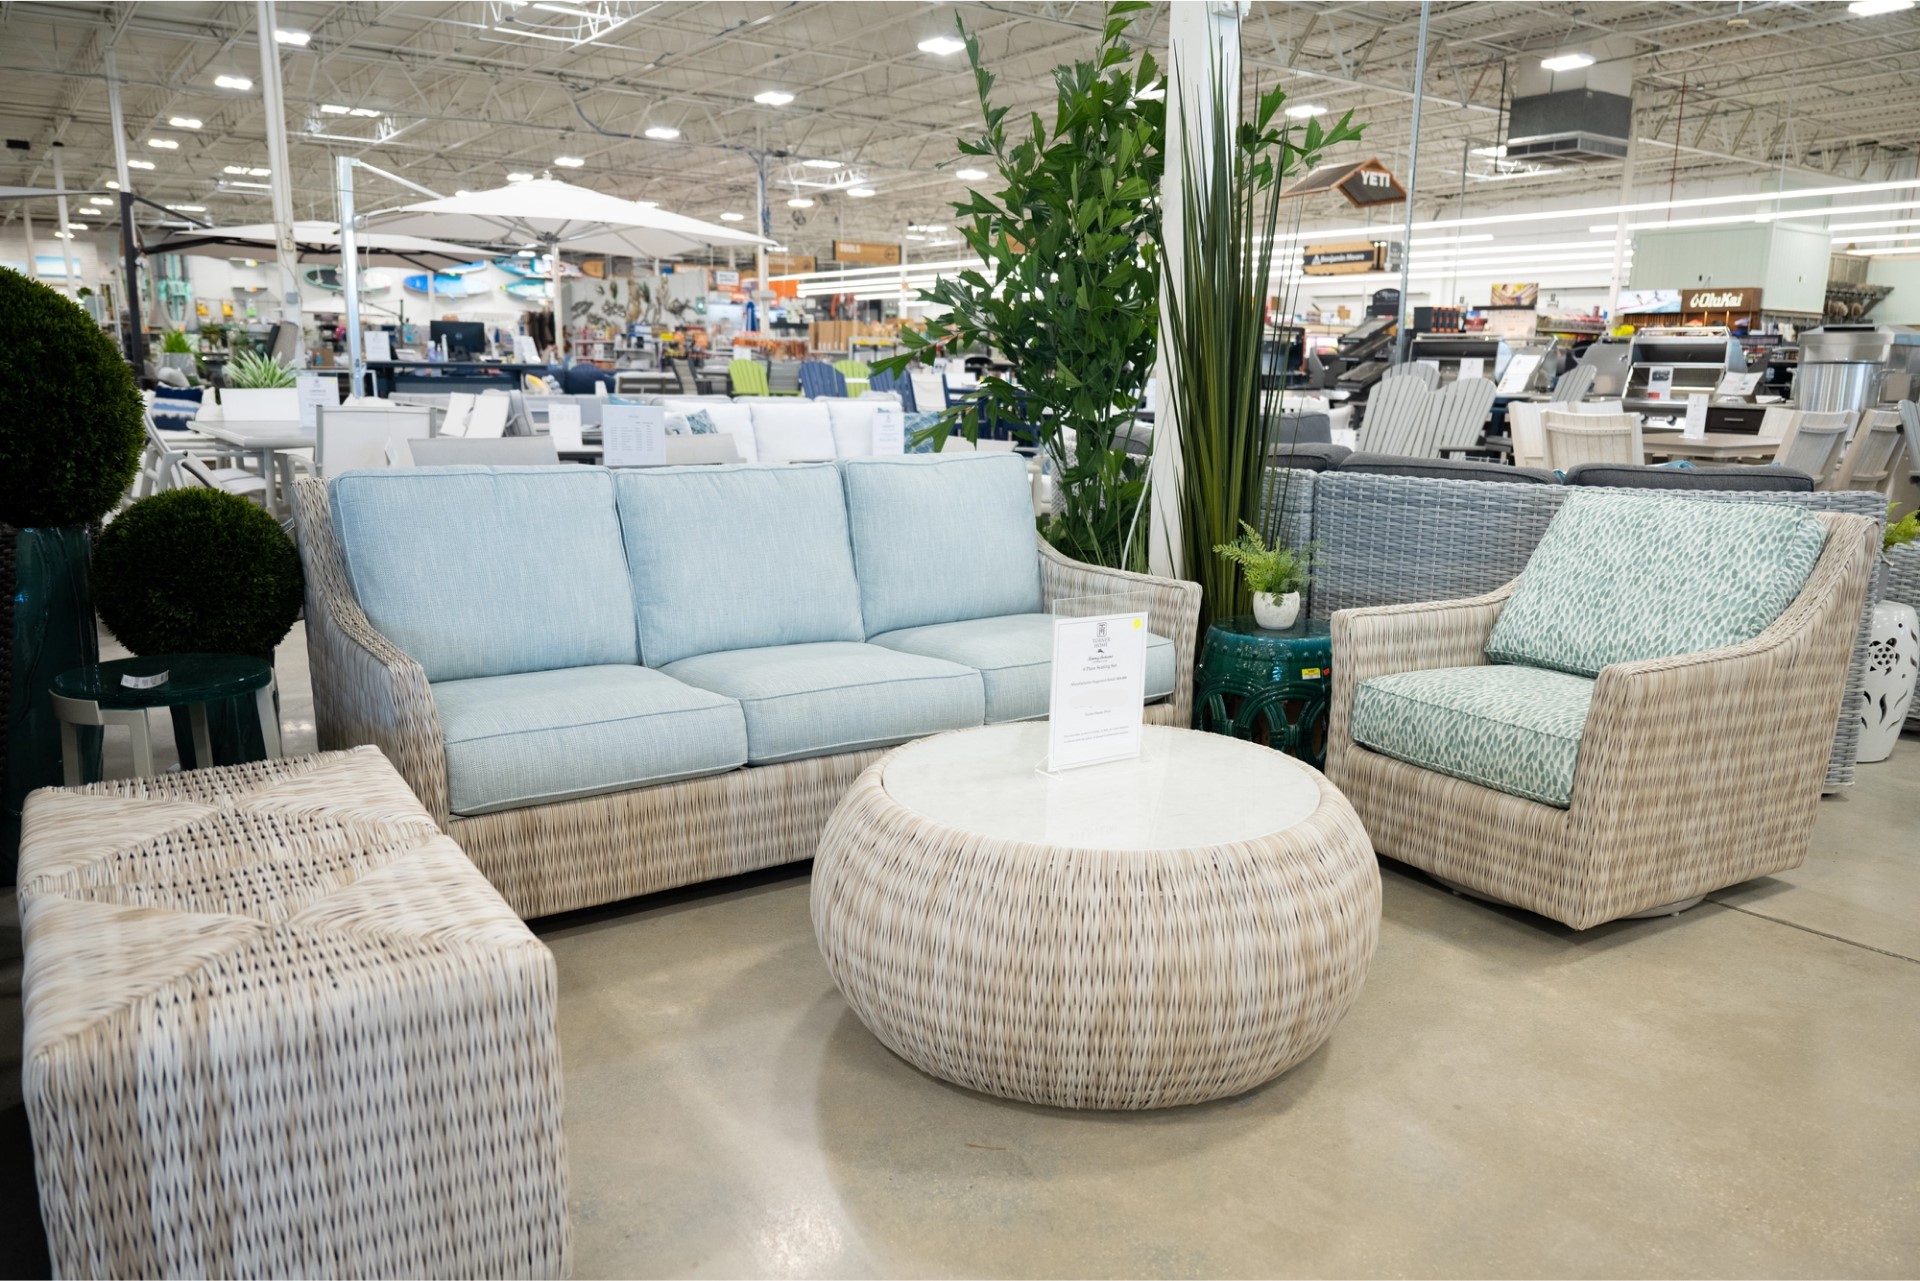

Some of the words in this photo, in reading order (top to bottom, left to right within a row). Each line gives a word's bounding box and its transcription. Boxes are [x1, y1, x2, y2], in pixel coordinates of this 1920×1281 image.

[1361, 169, 1390, 188] YETI
[1320, 254, 1345, 264] Benjamin
[1346, 253, 1365, 262] Moore
[1699, 292, 1744, 308] OluKai
